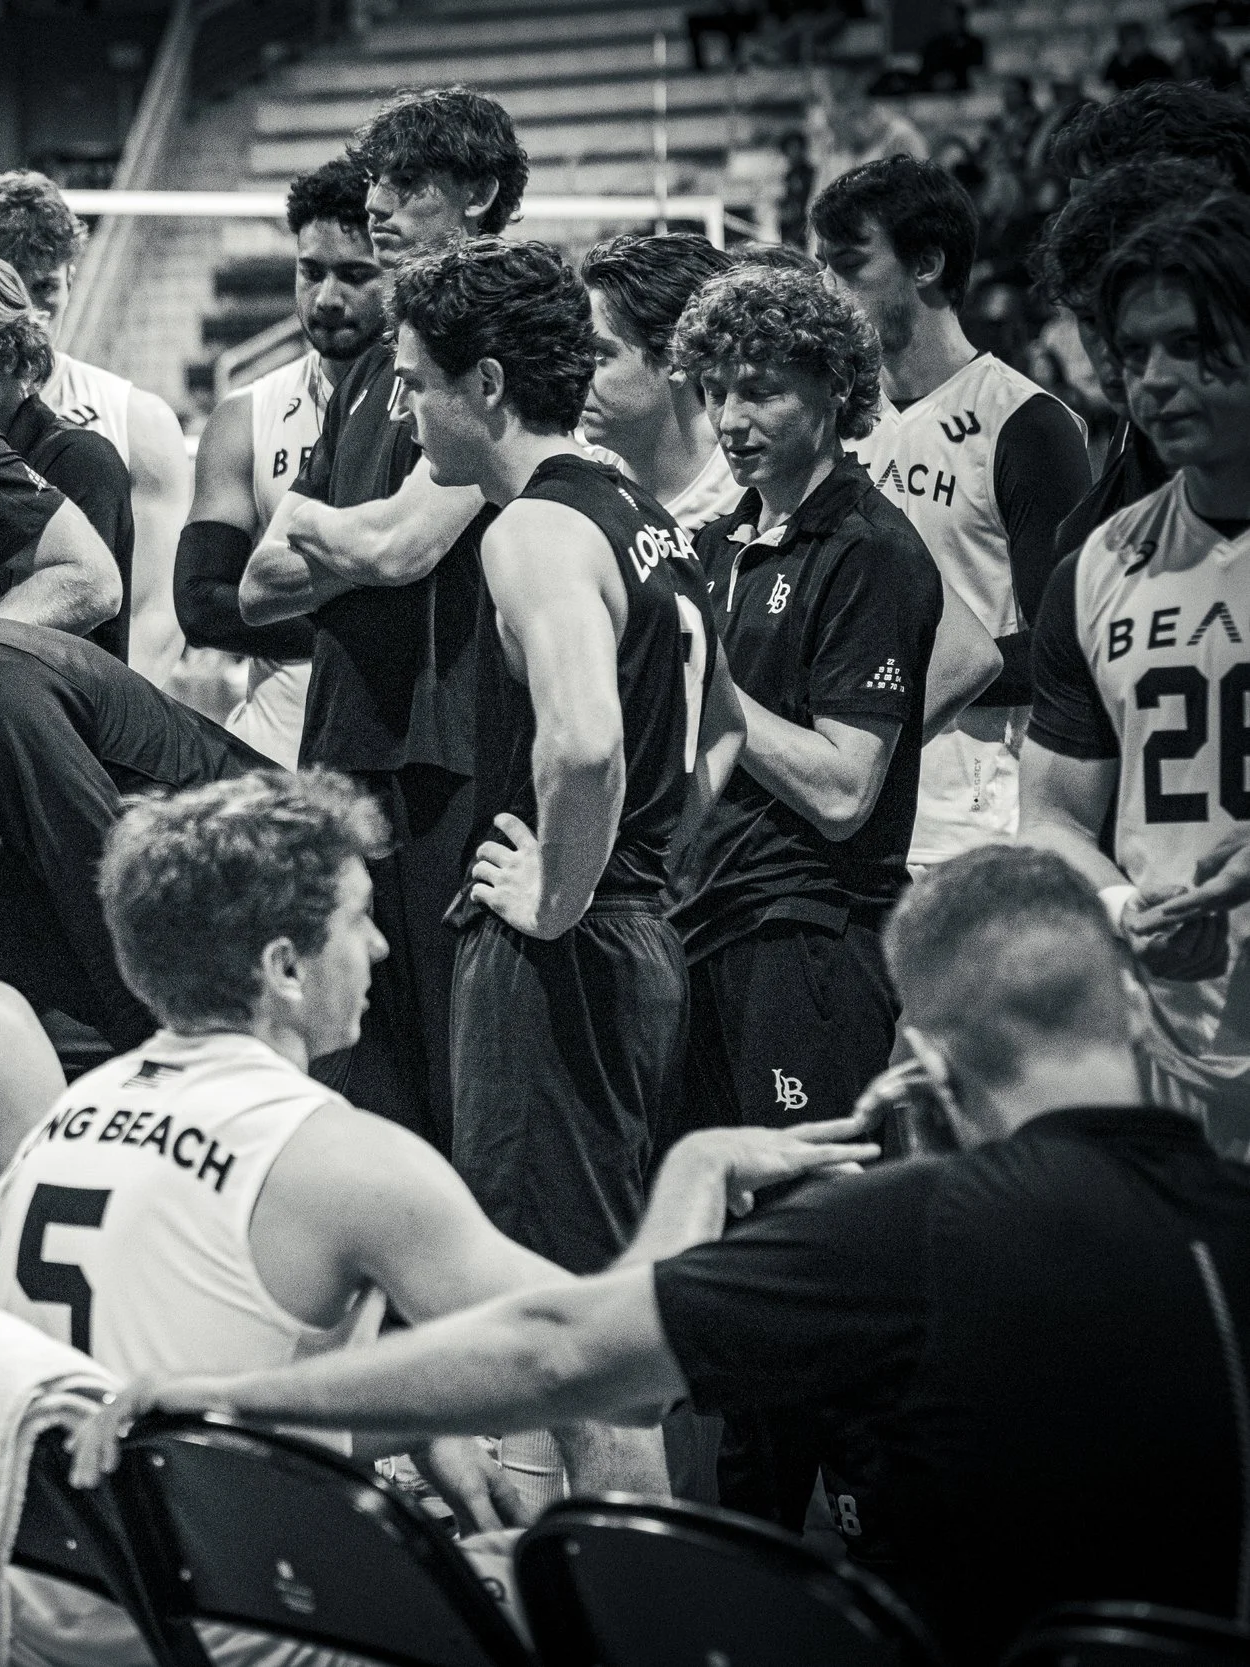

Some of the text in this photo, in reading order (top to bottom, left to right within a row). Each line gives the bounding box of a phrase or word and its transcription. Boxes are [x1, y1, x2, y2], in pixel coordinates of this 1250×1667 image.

[876, 459, 956, 507] ACH
[1108, 601, 1243, 662] BEA
[771, 1068, 809, 1111] LB
[41, 1106, 237, 1194] NG BEACH
[16, 1183, 113, 1359] 5
